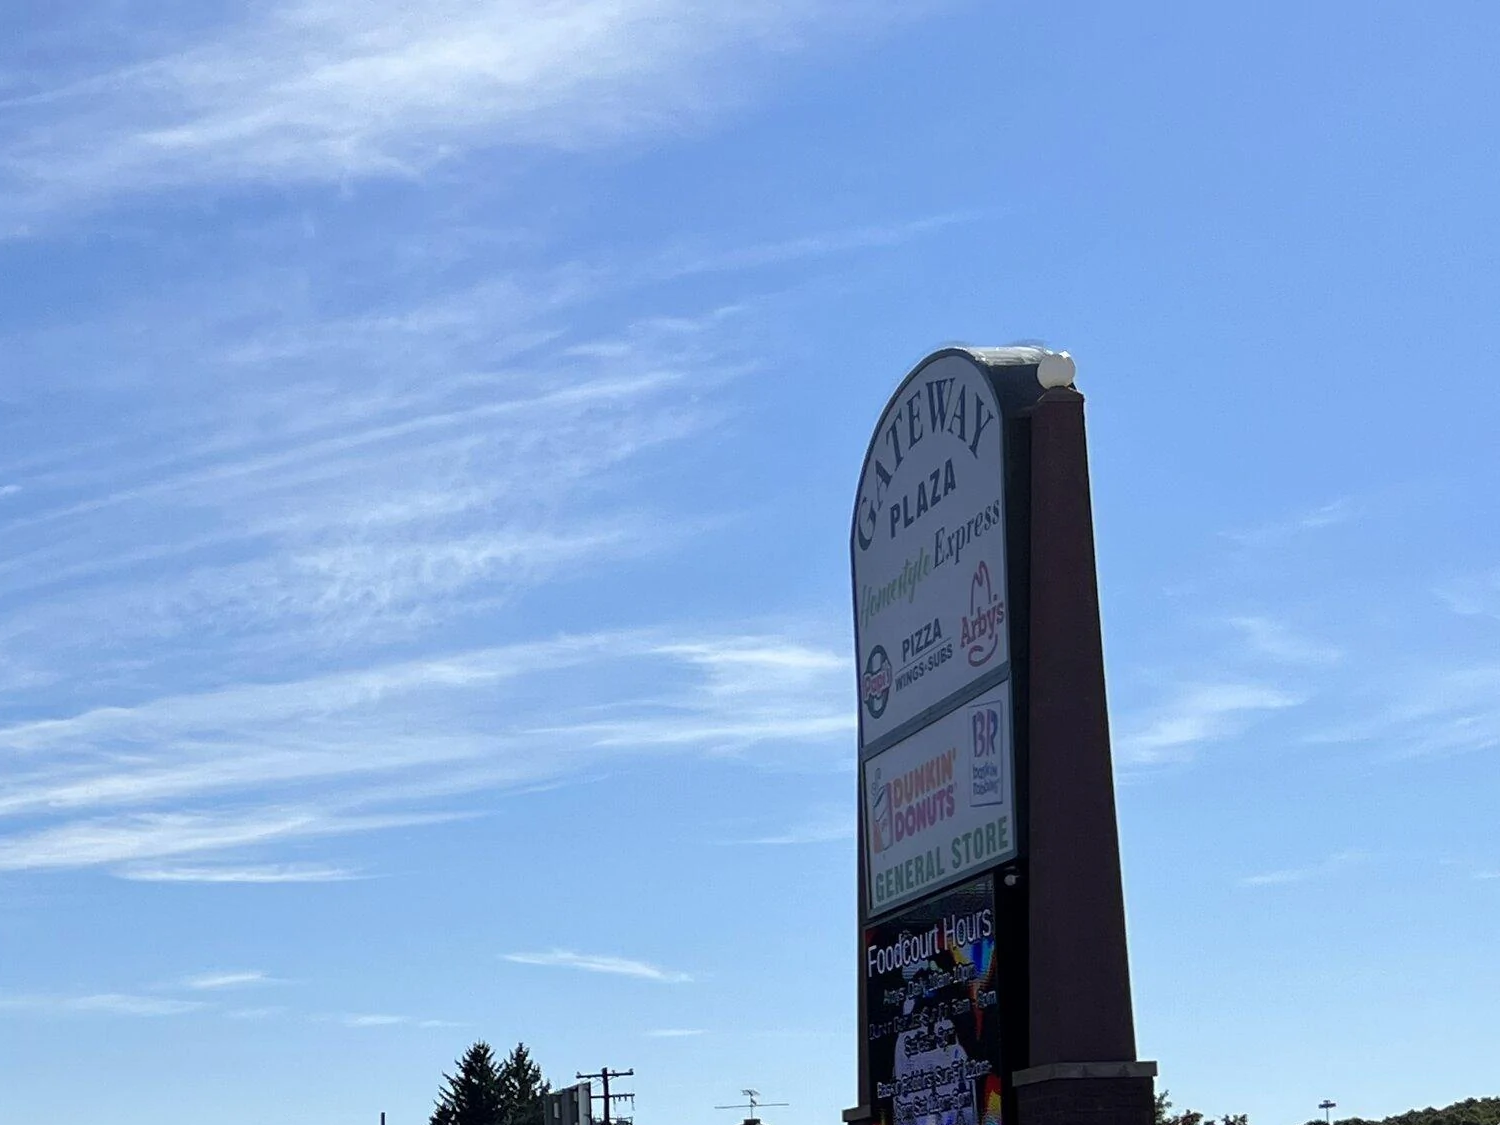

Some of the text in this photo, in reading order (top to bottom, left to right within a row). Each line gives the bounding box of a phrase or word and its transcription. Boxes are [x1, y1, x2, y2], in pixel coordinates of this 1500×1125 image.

[858, 377, 994, 552] GATEWAY
[889, 457, 957, 540] PLAZA
[860, 499, 1000, 629] Homestyle Express
[901, 617, 943, 663] PIZZA
[971, 708, 999, 758] BR
[893, 747, 956, 809] DUNKIN'
[894, 784, 956, 843] DONUTS
[875, 815, 1009, 903] GENERAL STORE
[867, 908, 992, 978] Foodcourt Hours
